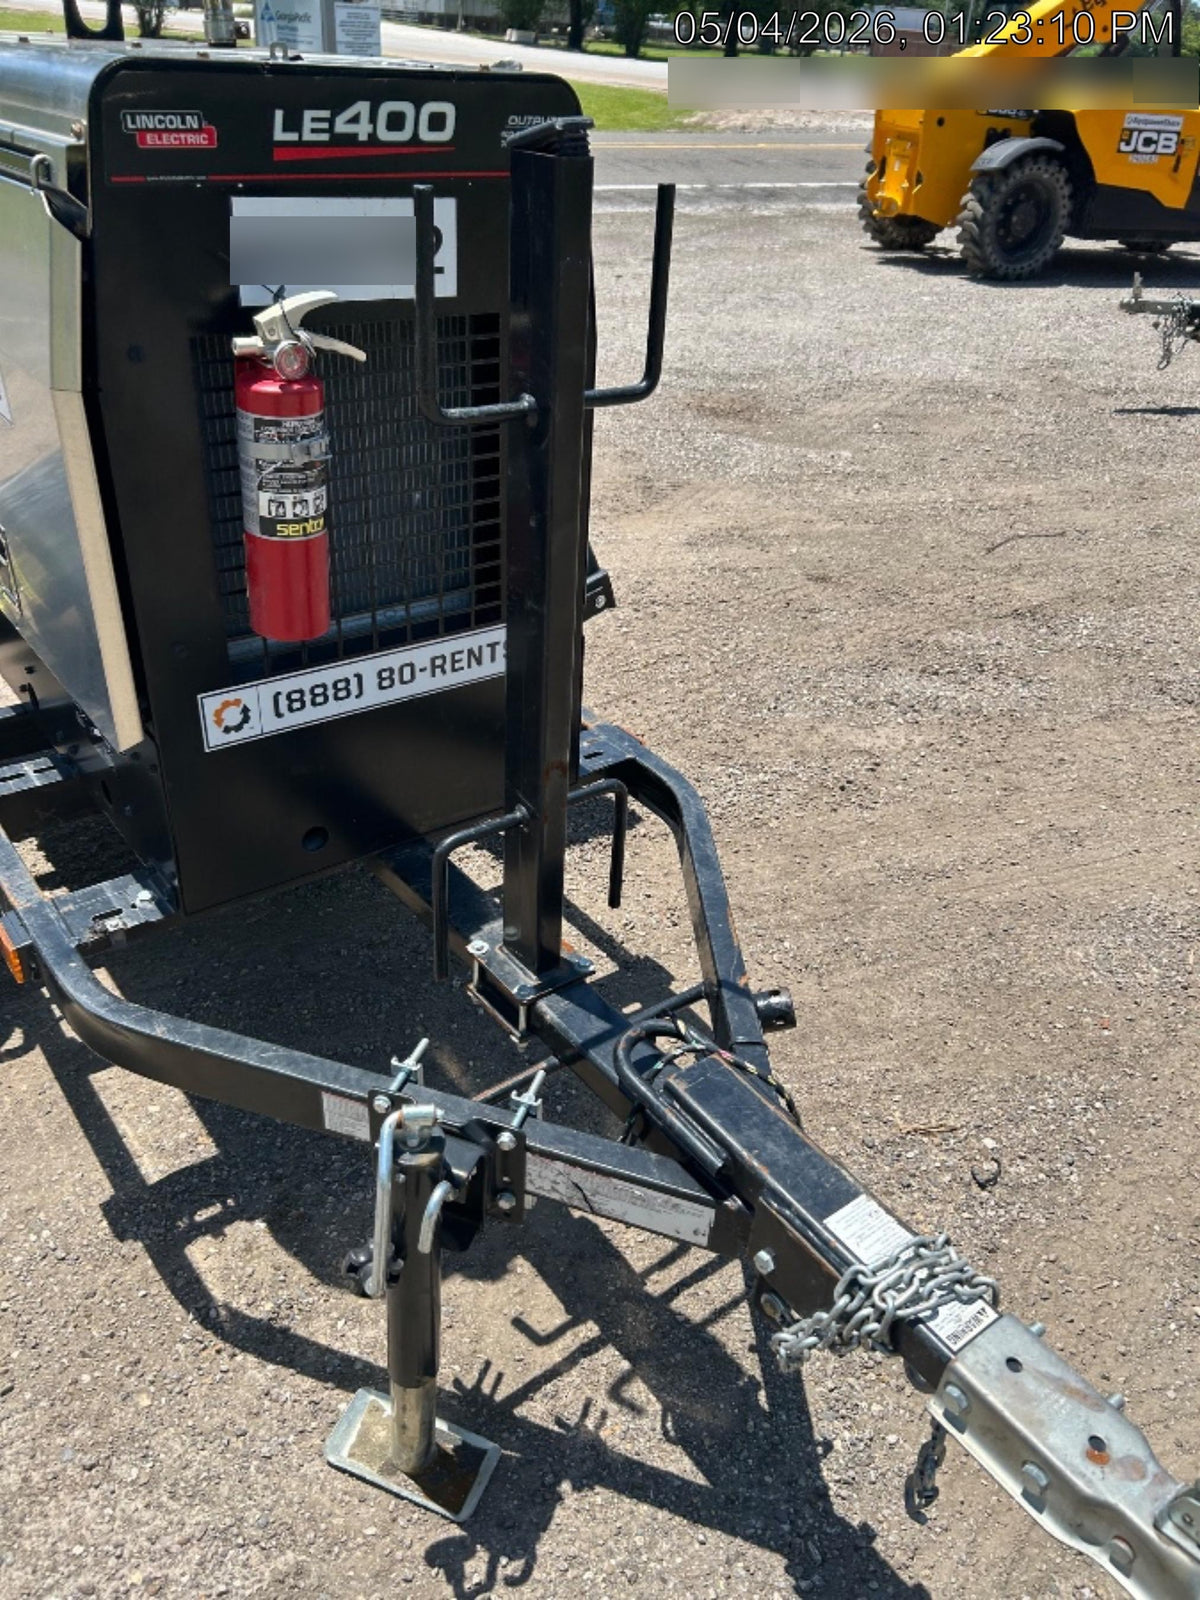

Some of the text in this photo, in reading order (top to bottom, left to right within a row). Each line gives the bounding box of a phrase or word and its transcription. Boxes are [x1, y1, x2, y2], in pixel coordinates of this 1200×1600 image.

[126, 114, 199, 129] LINCOLN
[273, 100, 456, 142] LE400
[146, 133, 209, 145] ELECTRIC
[1119, 130, 1179, 154] JCB
[272, 640, 507, 719] (888) 80-RENT
